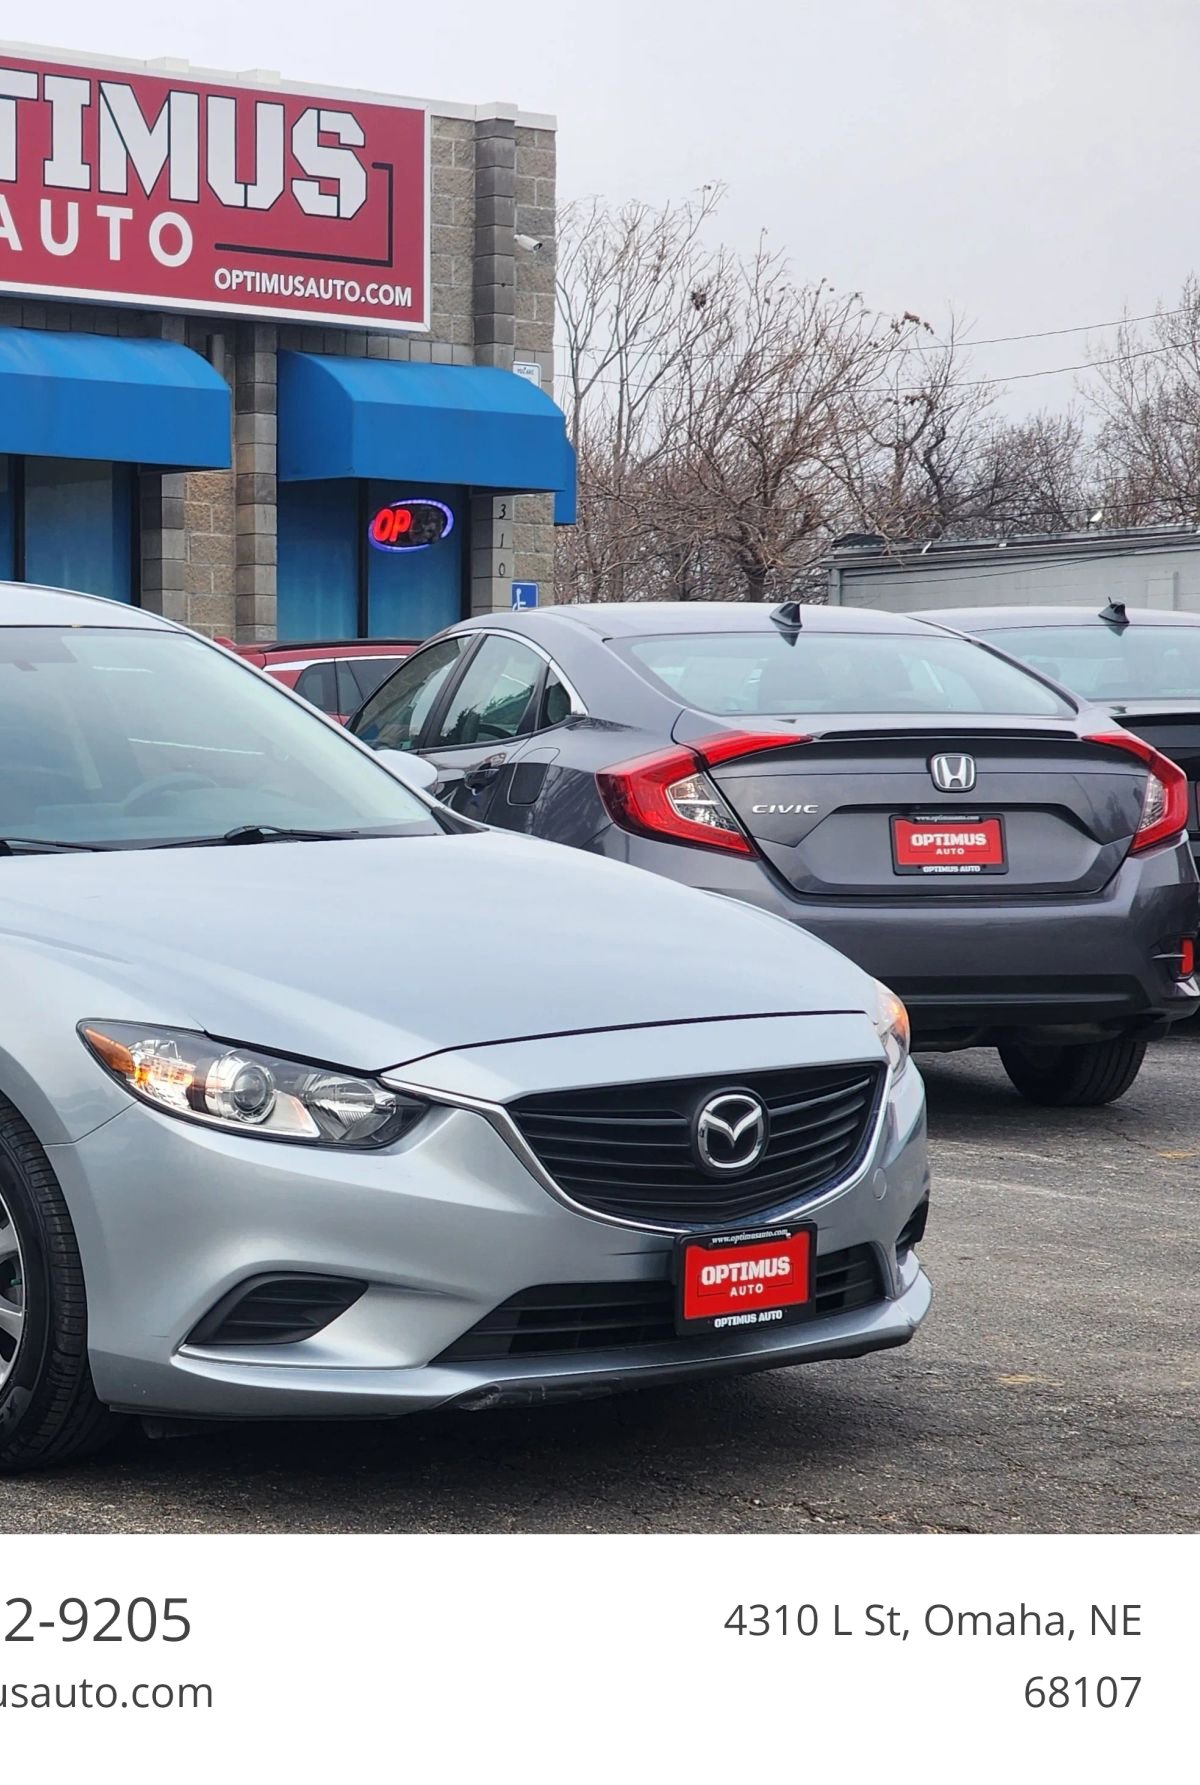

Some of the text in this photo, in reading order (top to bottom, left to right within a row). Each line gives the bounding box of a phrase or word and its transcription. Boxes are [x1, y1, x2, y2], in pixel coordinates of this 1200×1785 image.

[213, 268, 413, 308] OPTIMUSAUTO.COM
[751, 804, 819, 814] CIVIC
[910, 833, 987, 846] OPTIMUS
[935, 847, 965, 855] AUTO
[701, 1256, 791, 1286] OPTIMUS
[730, 1283, 764, 1297] AUTO
[714, 1309, 783, 1328] OPTIMUS AUTO
